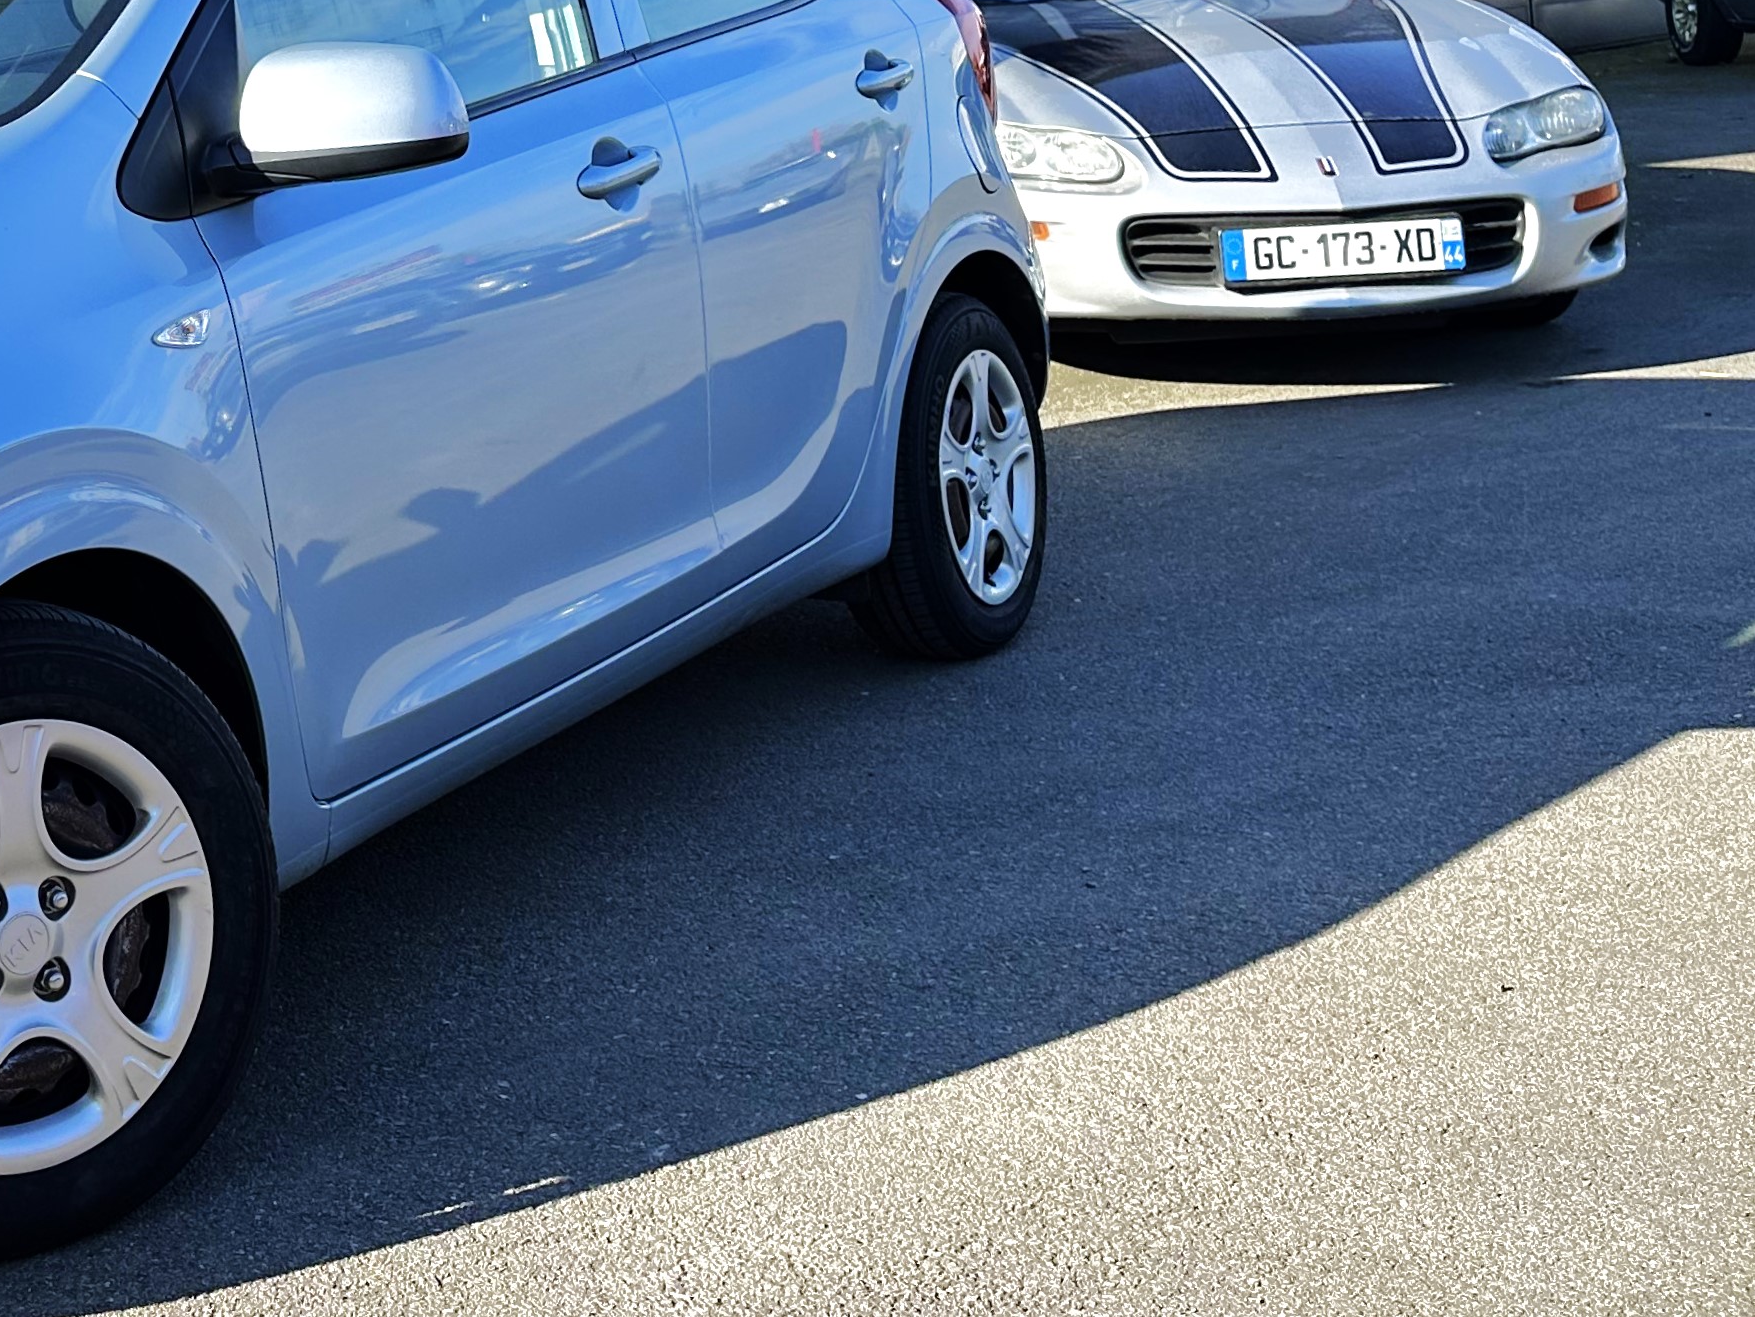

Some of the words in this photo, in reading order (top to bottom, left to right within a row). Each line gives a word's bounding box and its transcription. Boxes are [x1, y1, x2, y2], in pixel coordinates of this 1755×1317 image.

[1252, 227, 1437, 271] GC-173-XD
[1445, 244, 1464, 263] 44
[1231, 259, 1240, 271] F
